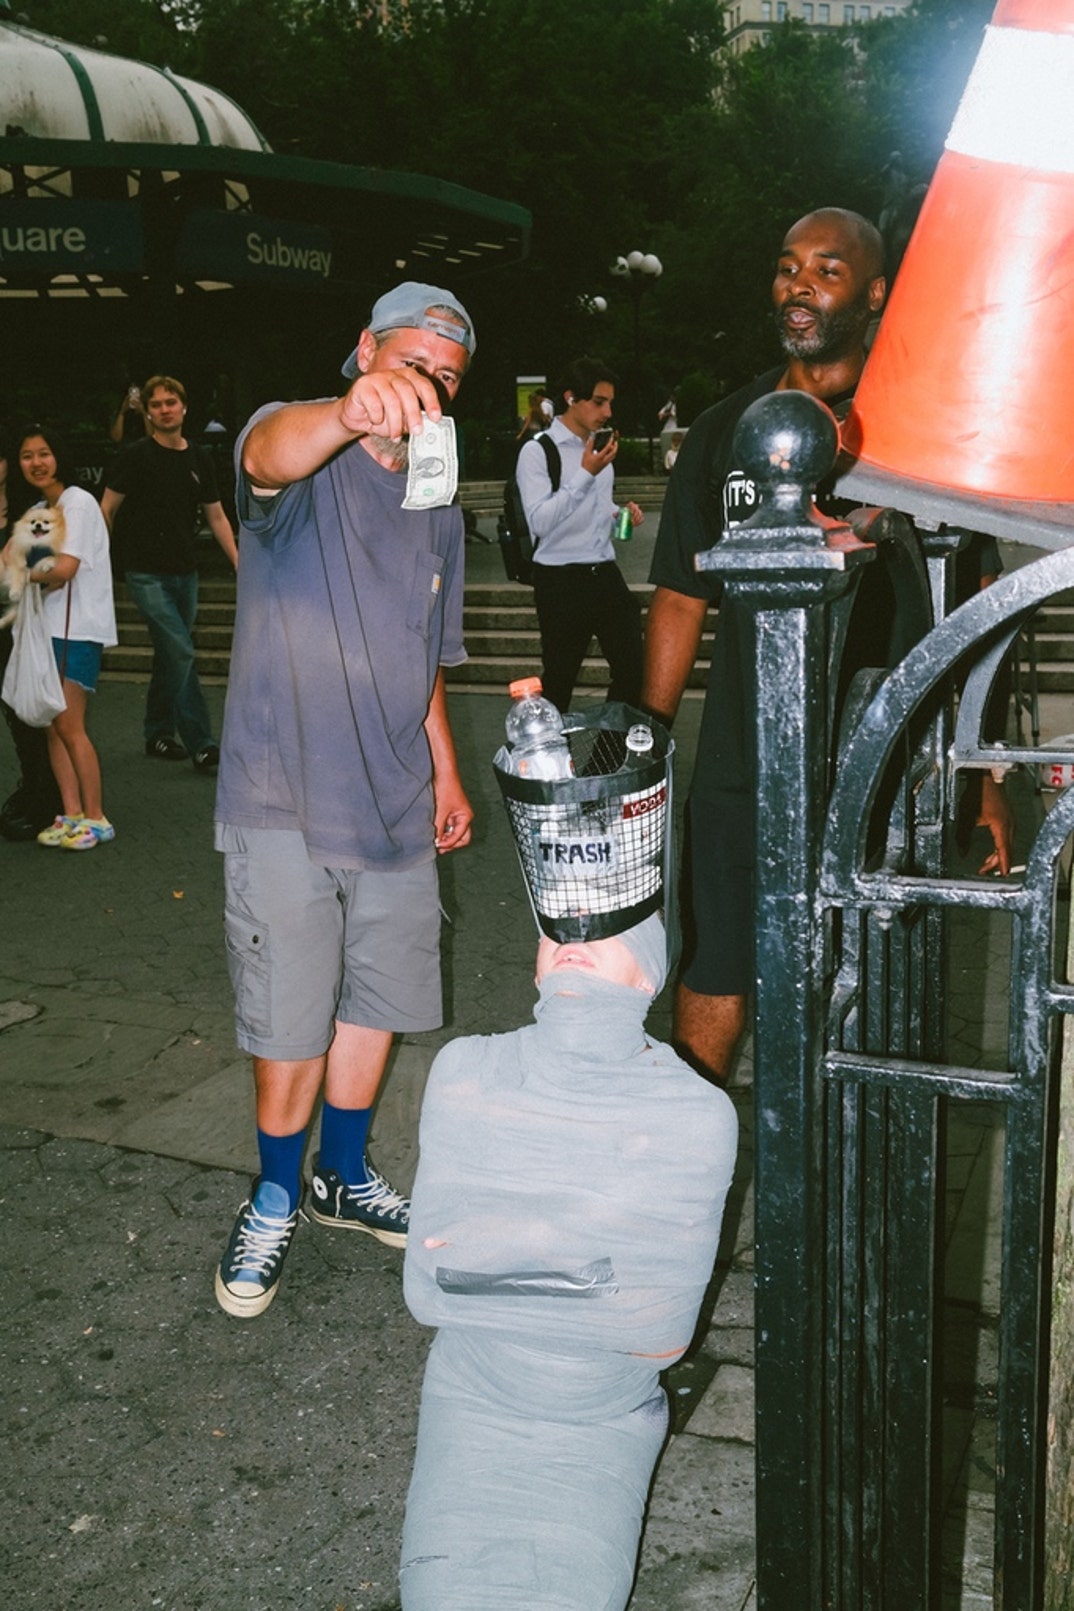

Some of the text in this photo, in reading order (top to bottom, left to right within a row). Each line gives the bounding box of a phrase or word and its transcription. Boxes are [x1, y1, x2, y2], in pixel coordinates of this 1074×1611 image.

[0, 226, 86, 255] uare
[246, 232, 332, 277] Subway
[728, 479, 755, 507] IT'S
[538, 841, 611, 864] TRASH
